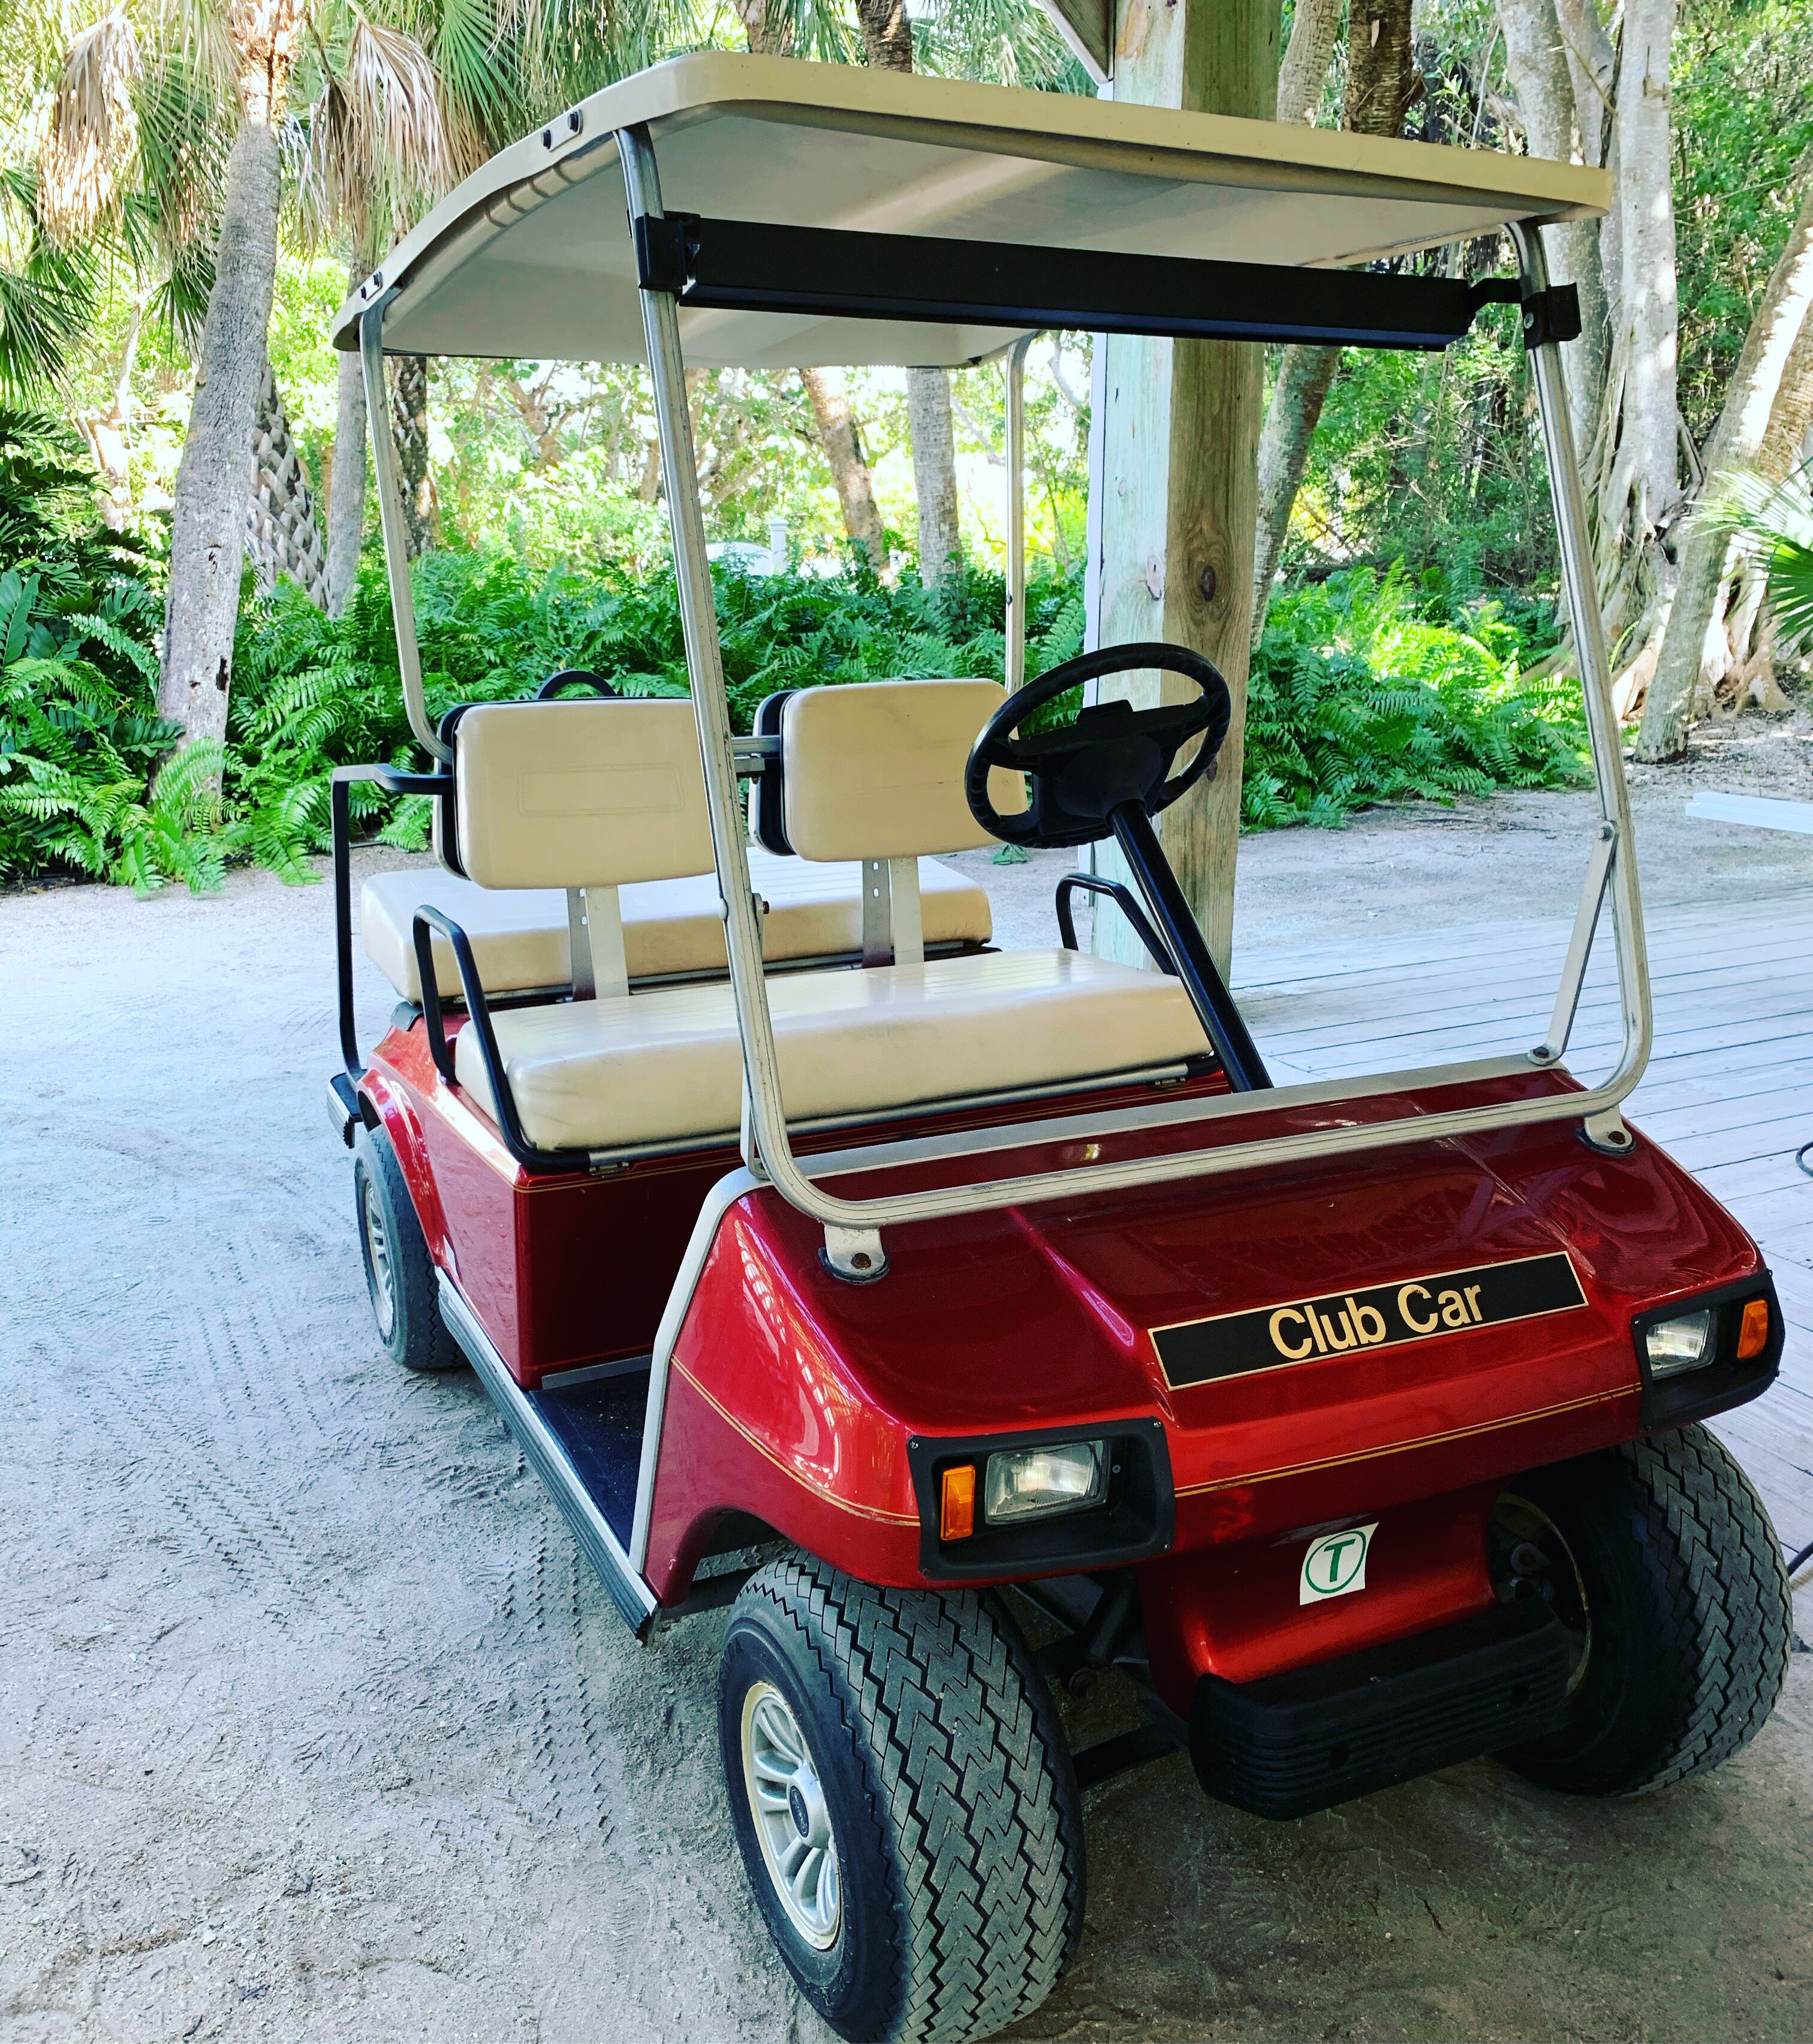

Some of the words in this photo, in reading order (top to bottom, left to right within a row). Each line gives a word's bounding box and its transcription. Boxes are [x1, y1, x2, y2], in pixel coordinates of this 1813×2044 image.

[1269, 1298, 1386, 1359] Club
[1398, 1284, 1483, 1333] Car
[1324, 1539, 1356, 1582] T
